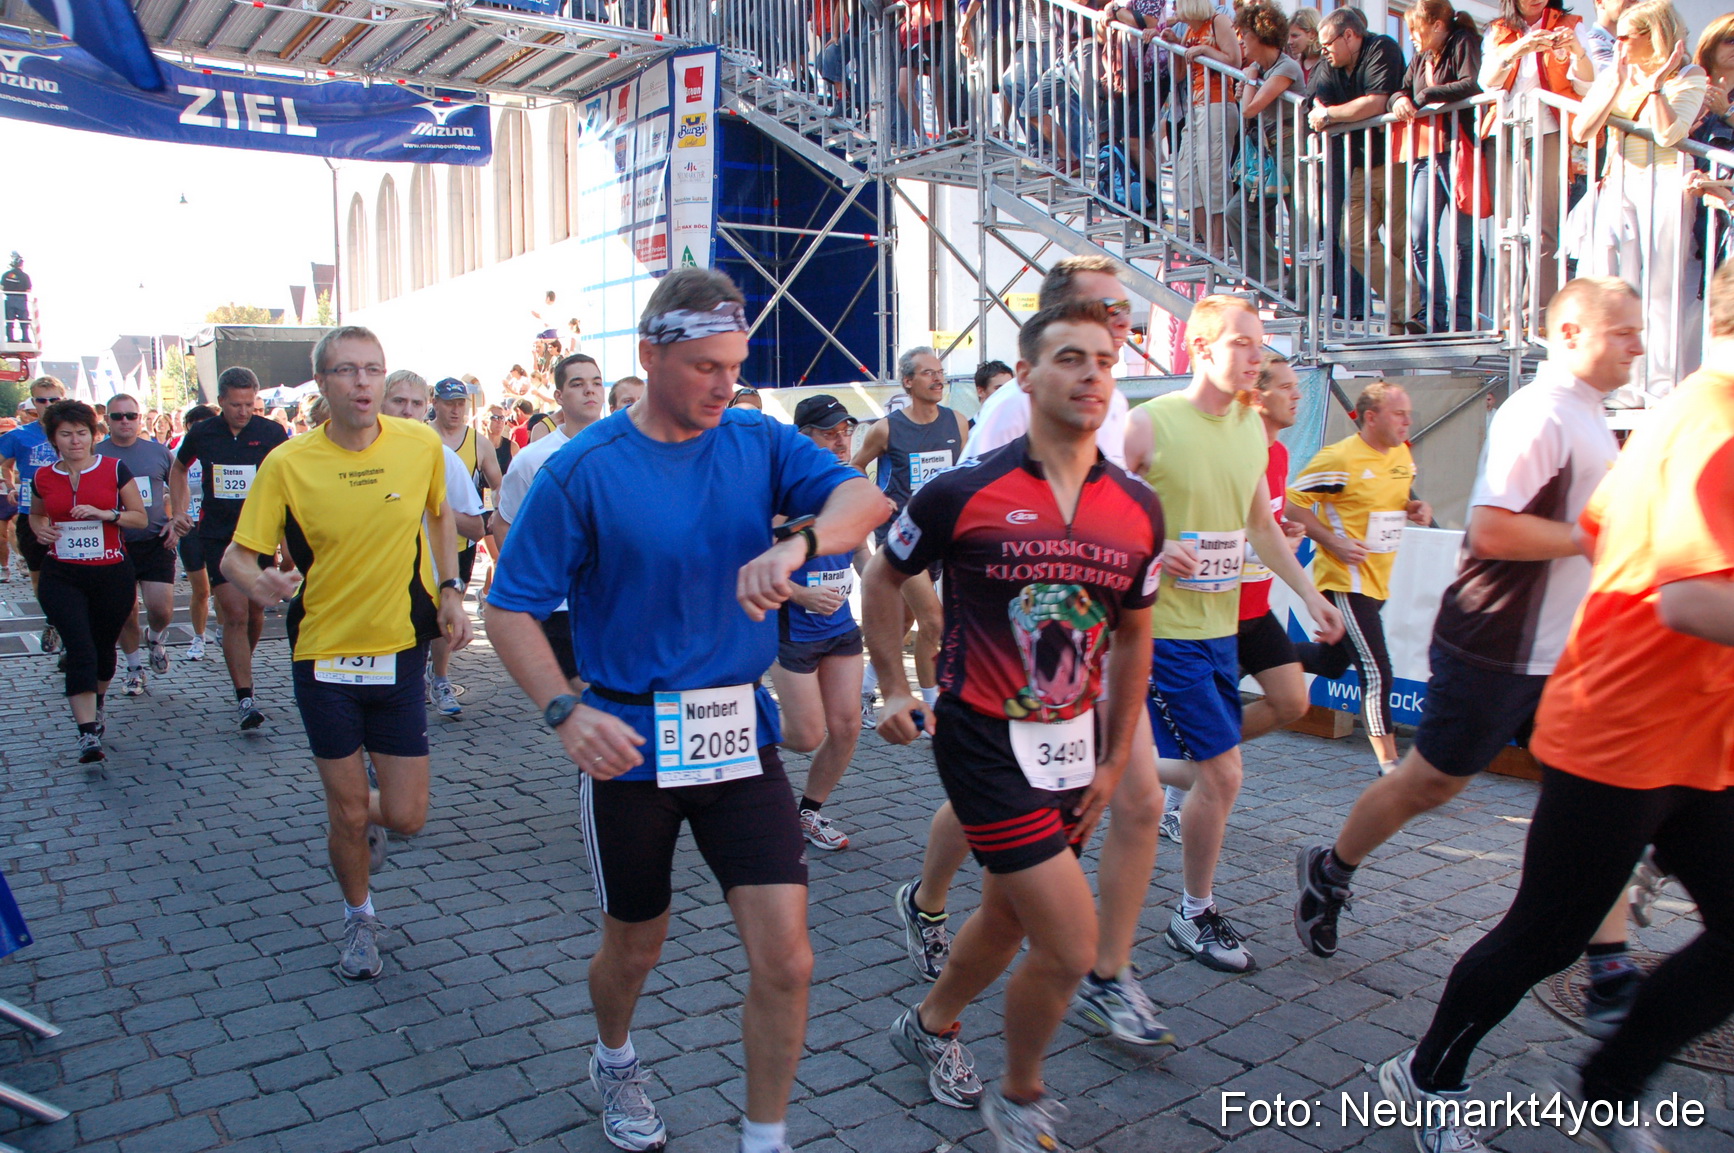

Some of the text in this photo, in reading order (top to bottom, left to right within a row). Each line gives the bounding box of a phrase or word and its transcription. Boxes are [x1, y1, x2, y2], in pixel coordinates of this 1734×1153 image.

[177, 84, 318, 138] ZIEL
[410, 122, 474, 137] MIZUNO
[403, 142, 481, 152] www.mizunoeurope.com
[224, 480, 246, 490] 329
[349, 478, 378, 487] Triathlon
[68, 524, 99, 532] Hannelore
[67, 537, 100, 549] 3488
[1200, 539, 1238, 550] Andreas
[1199, 557, 1240, 576] 2194
[822, 571, 845, 581] Harald
[686, 700, 738, 720] Norbert
[664, 727, 750, 760] B 2085
[1037, 738, 1087, 766] 3490
